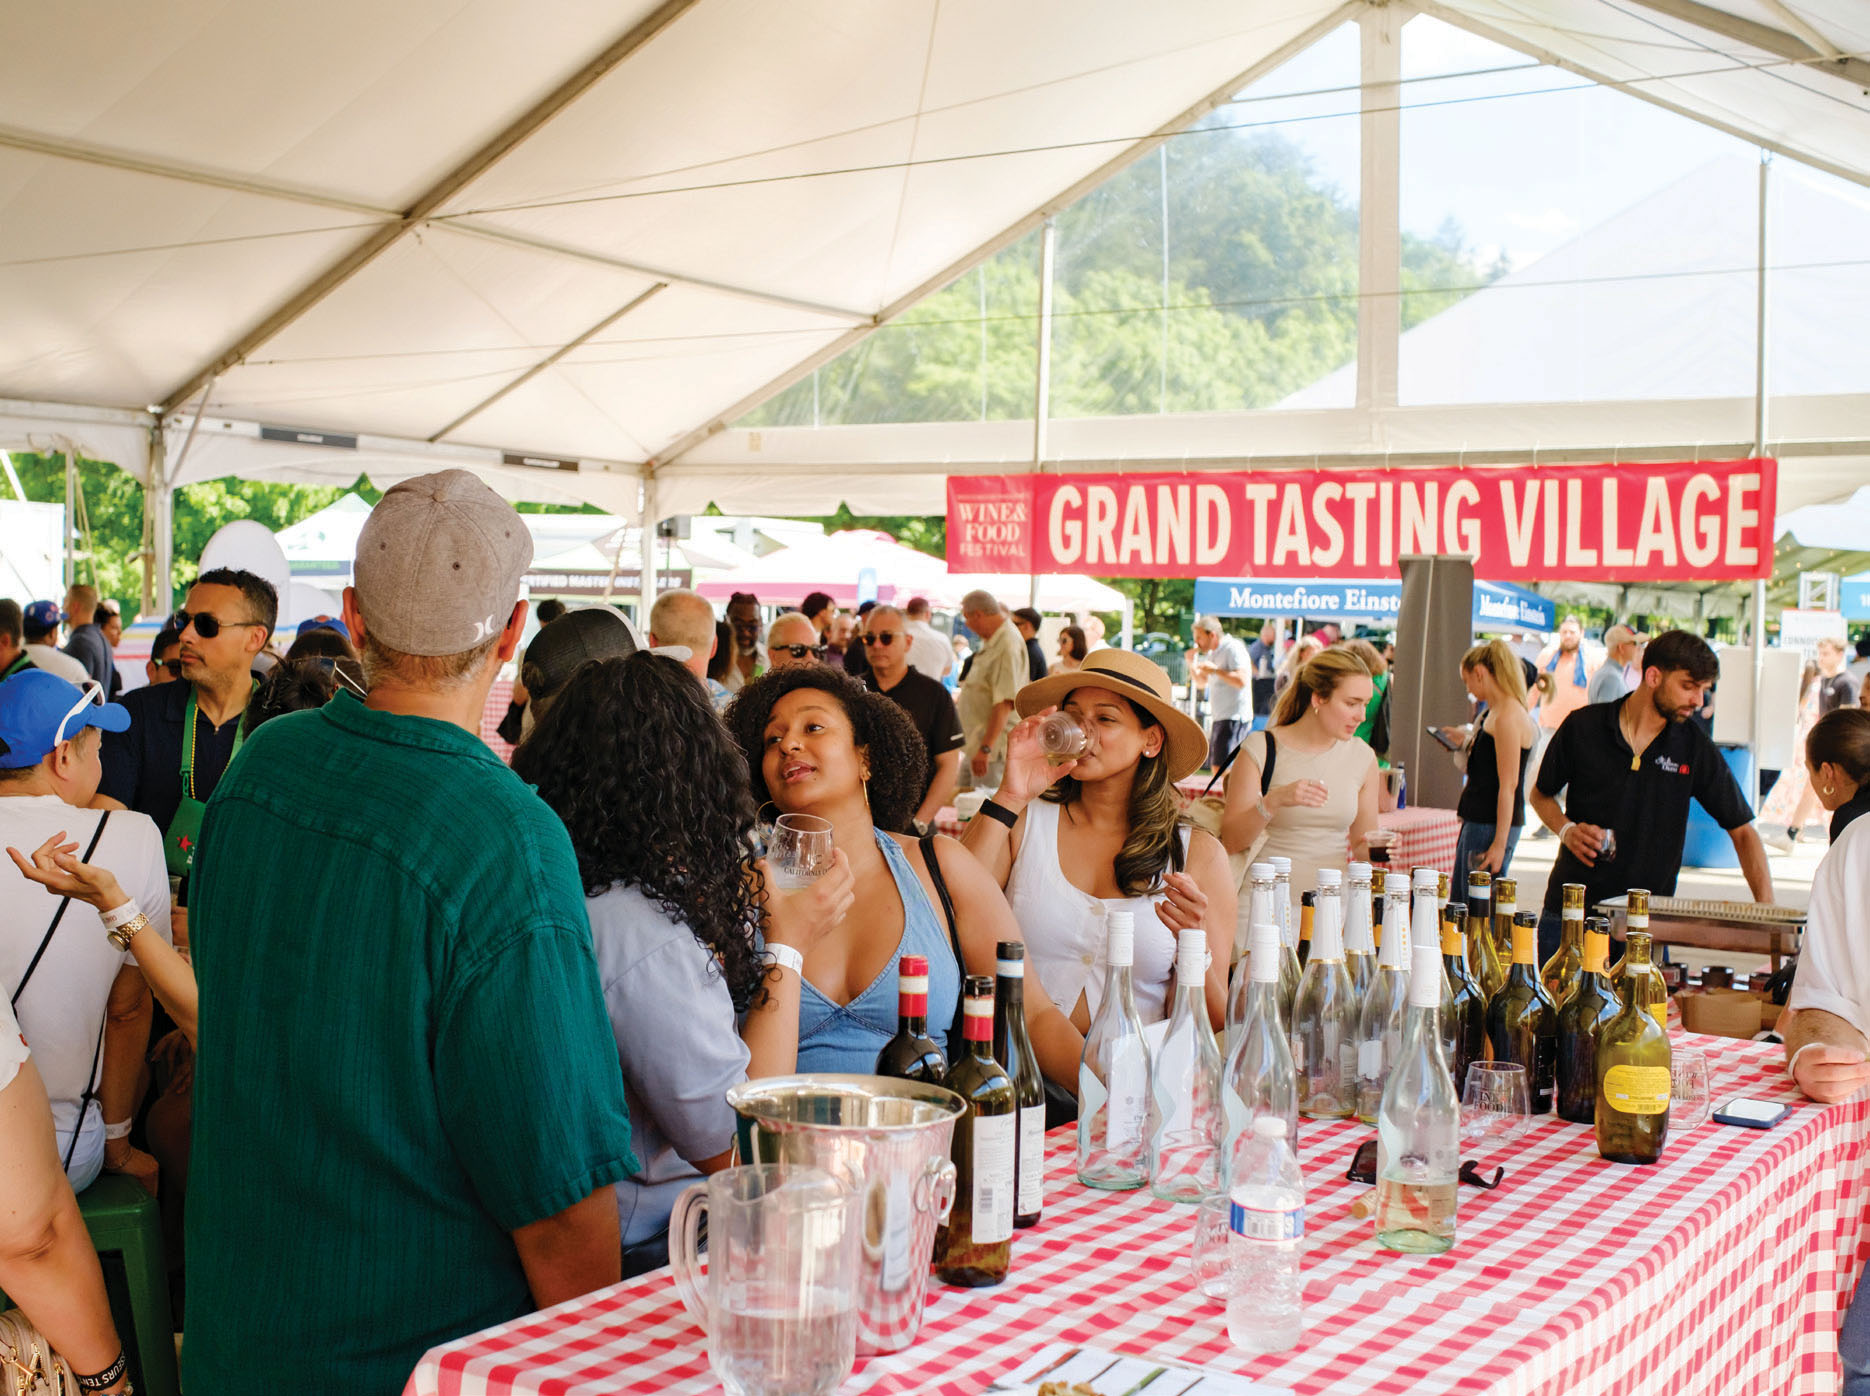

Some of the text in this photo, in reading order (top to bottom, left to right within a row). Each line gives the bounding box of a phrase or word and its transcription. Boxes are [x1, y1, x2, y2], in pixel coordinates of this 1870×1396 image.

[1048, 473, 1761, 567] GRAND TASTING VILLAGE
[966, 522, 1020, 542] FOOD
[960, 543, 1026, 557] FESTIVAL
[1229, 586, 1401, 612] Montefiore Einst
